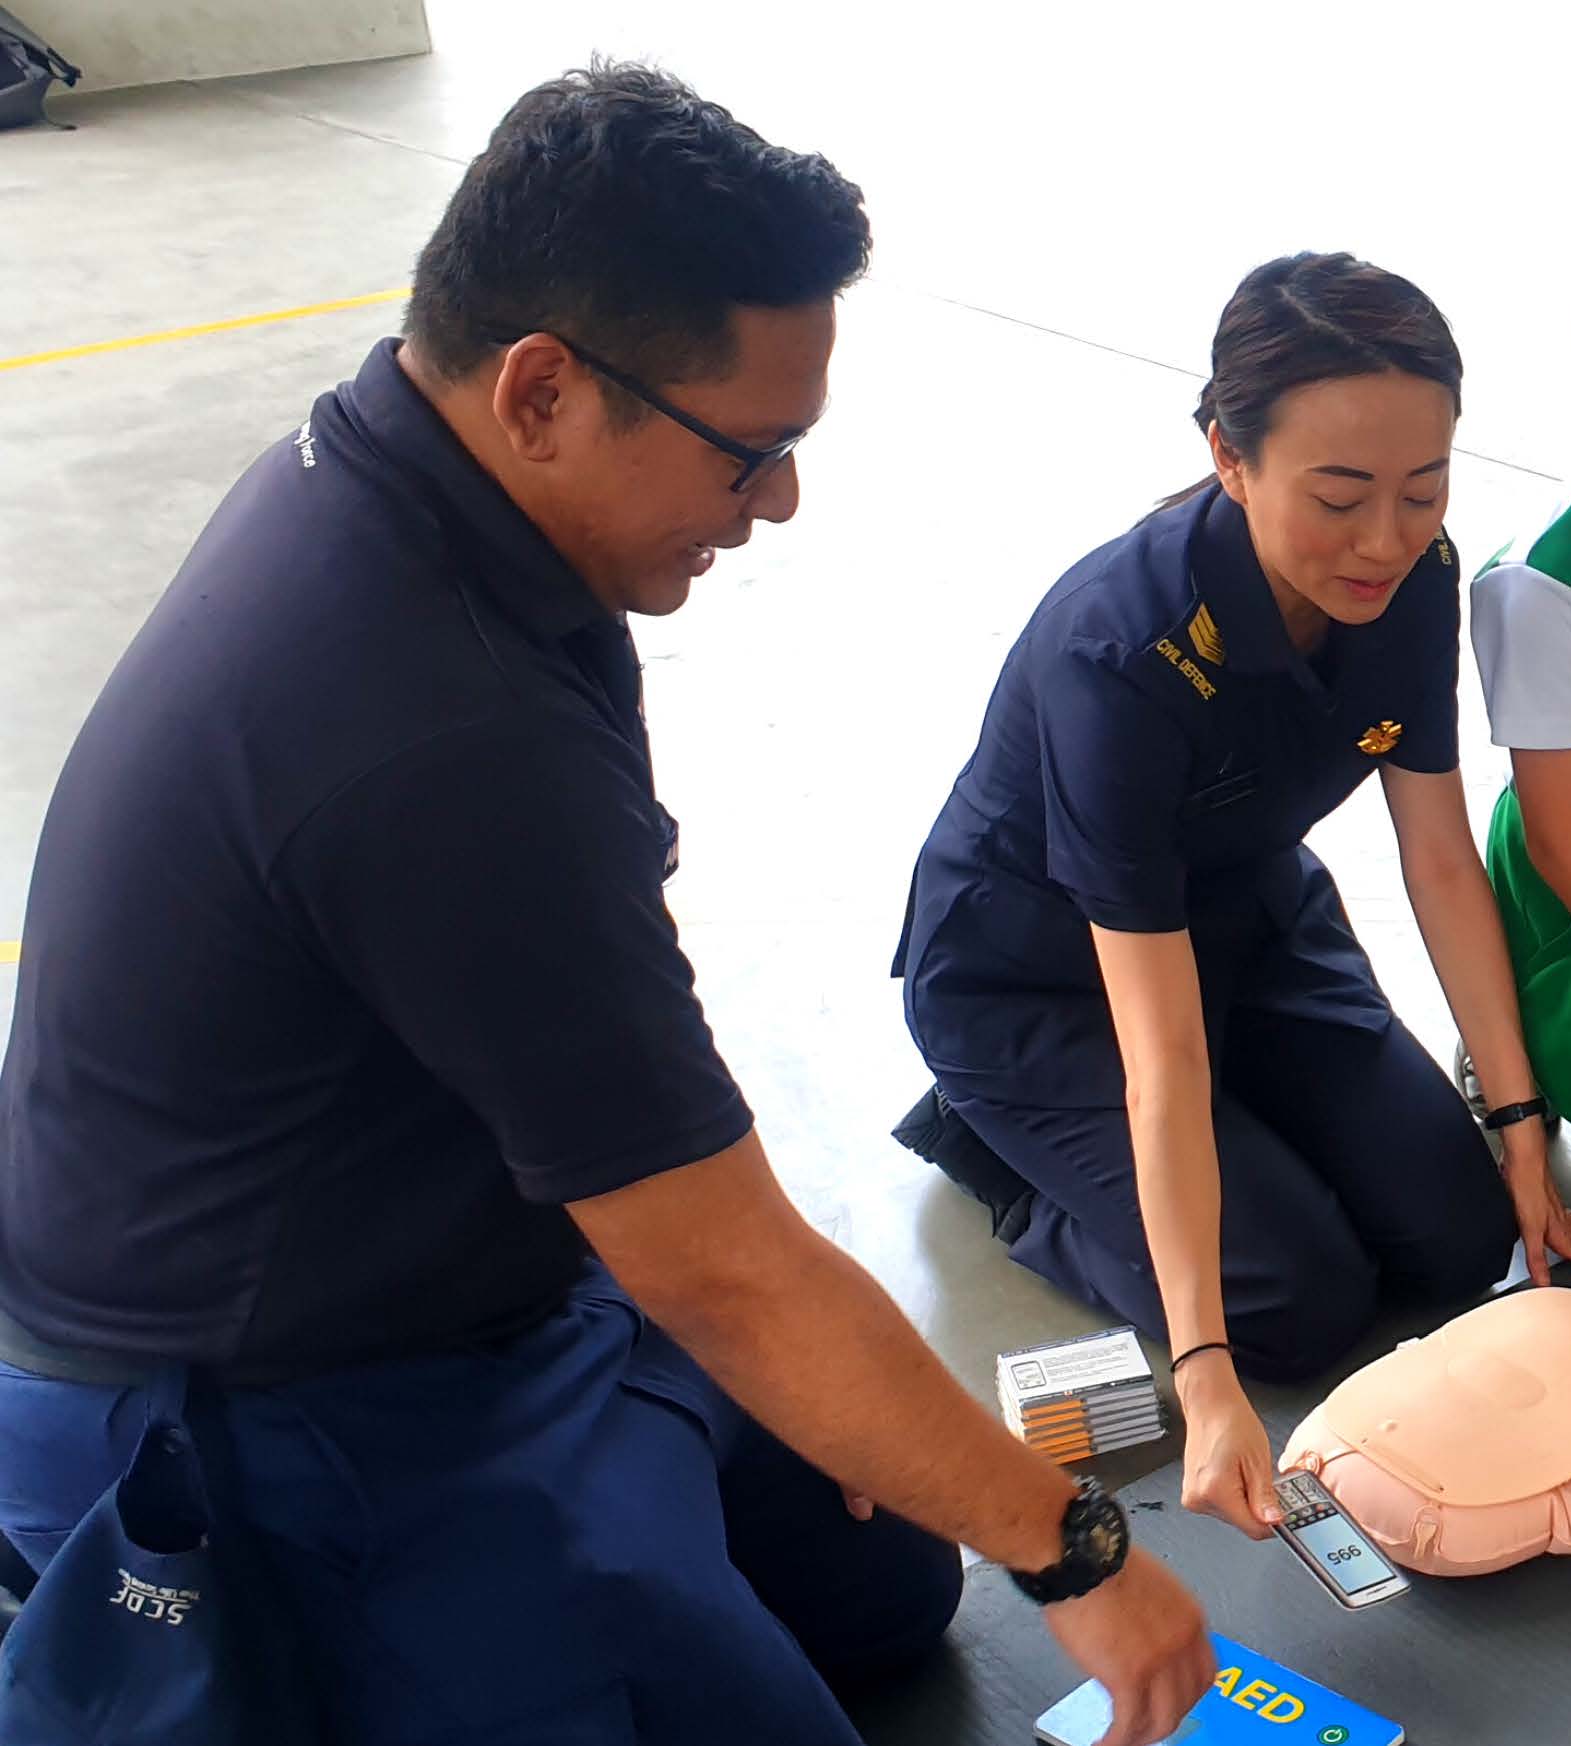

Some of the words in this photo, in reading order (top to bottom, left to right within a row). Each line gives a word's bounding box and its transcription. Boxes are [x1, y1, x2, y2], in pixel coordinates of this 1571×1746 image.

[1156, 638, 1182, 665] CIVIL
[1178, 658, 1217, 701] DEFENCE
[1326, 1544, 1362, 1566] 995
[109, 1584, 192, 1625] SCDF
[1213, 1666, 1306, 1724] AED
